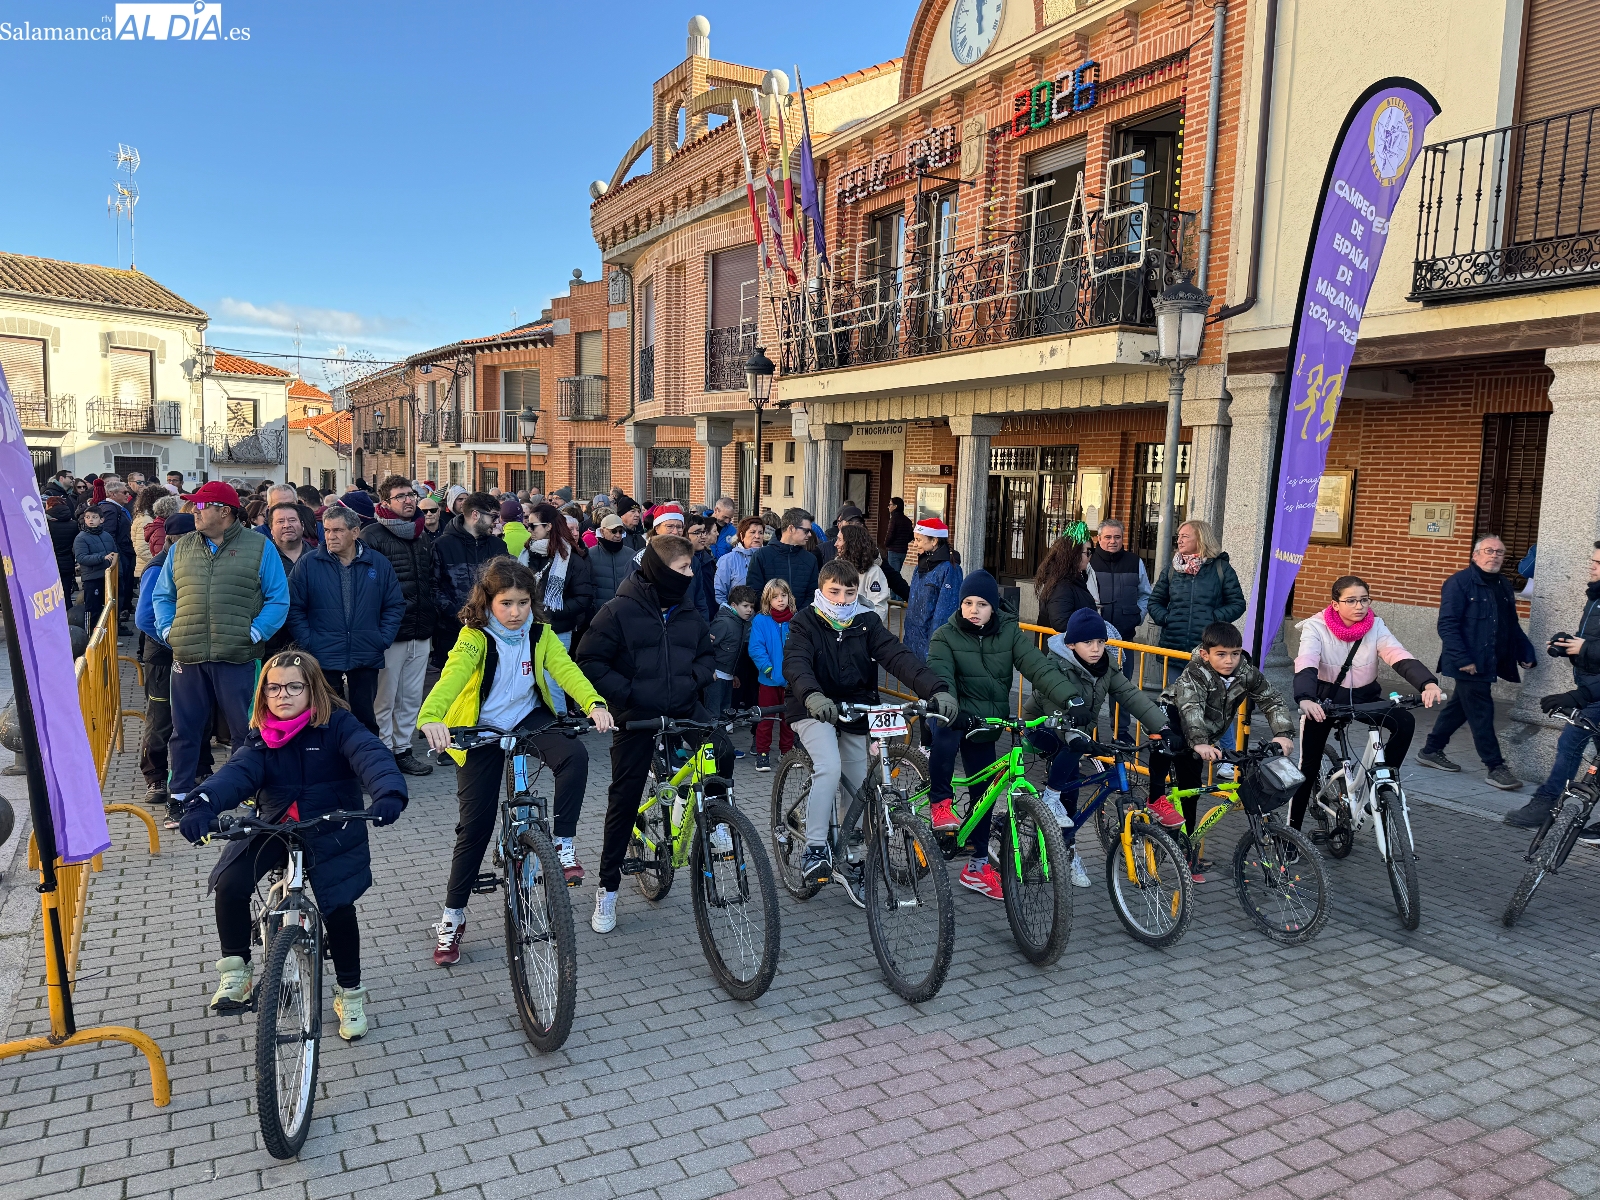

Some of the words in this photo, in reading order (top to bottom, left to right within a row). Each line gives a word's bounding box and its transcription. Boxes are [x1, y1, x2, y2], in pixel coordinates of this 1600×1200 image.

[1011, 59, 1096, 138] 2026
[1350, 218, 1365, 242] DE
[1332, 232, 1369, 273] ESPAÑA
[1335, 264, 1353, 287] DE
[875, 713, 898, 728] 387
